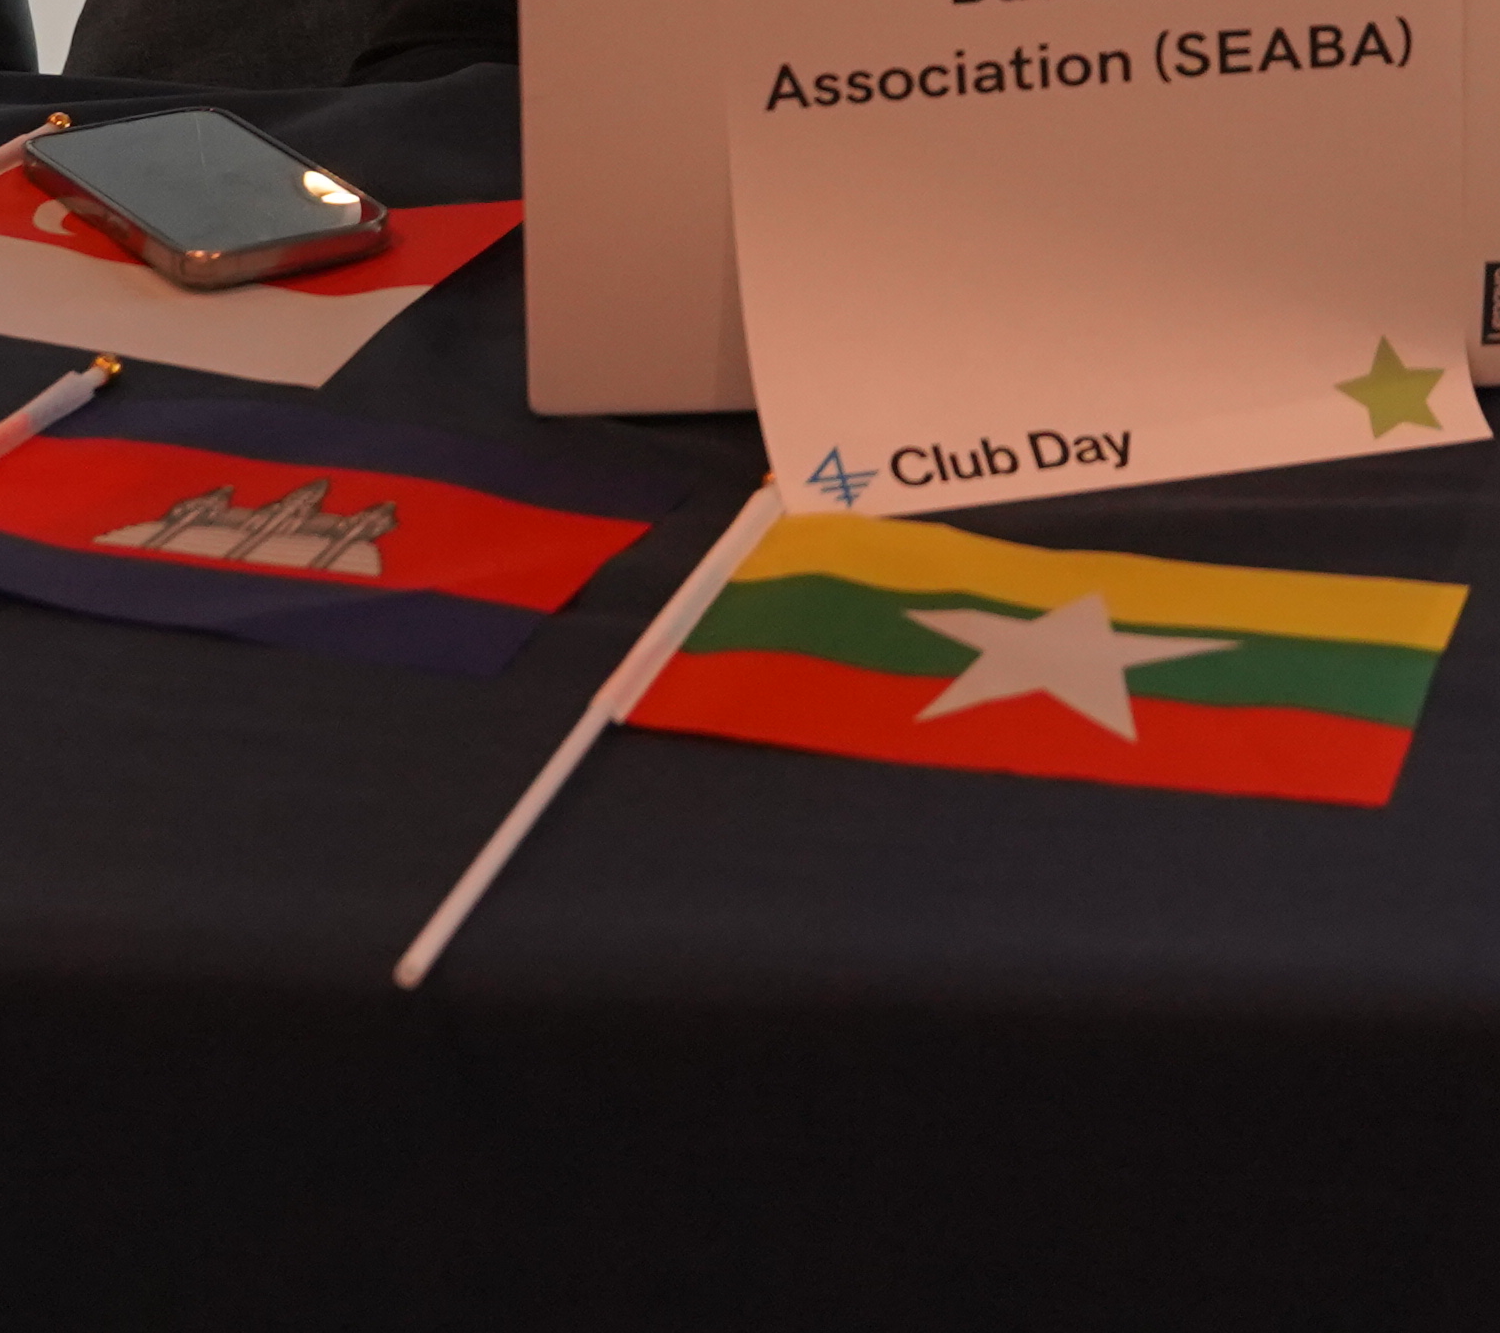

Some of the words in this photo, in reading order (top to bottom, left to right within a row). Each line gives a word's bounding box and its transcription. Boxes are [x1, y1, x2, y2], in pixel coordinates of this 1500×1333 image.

[765, 43, 1133, 111] Association
[1155, 16, 1414, 84] (SEABA)
[890, 438, 1020, 487] Club
[1027, 430, 1131, 469] Day
